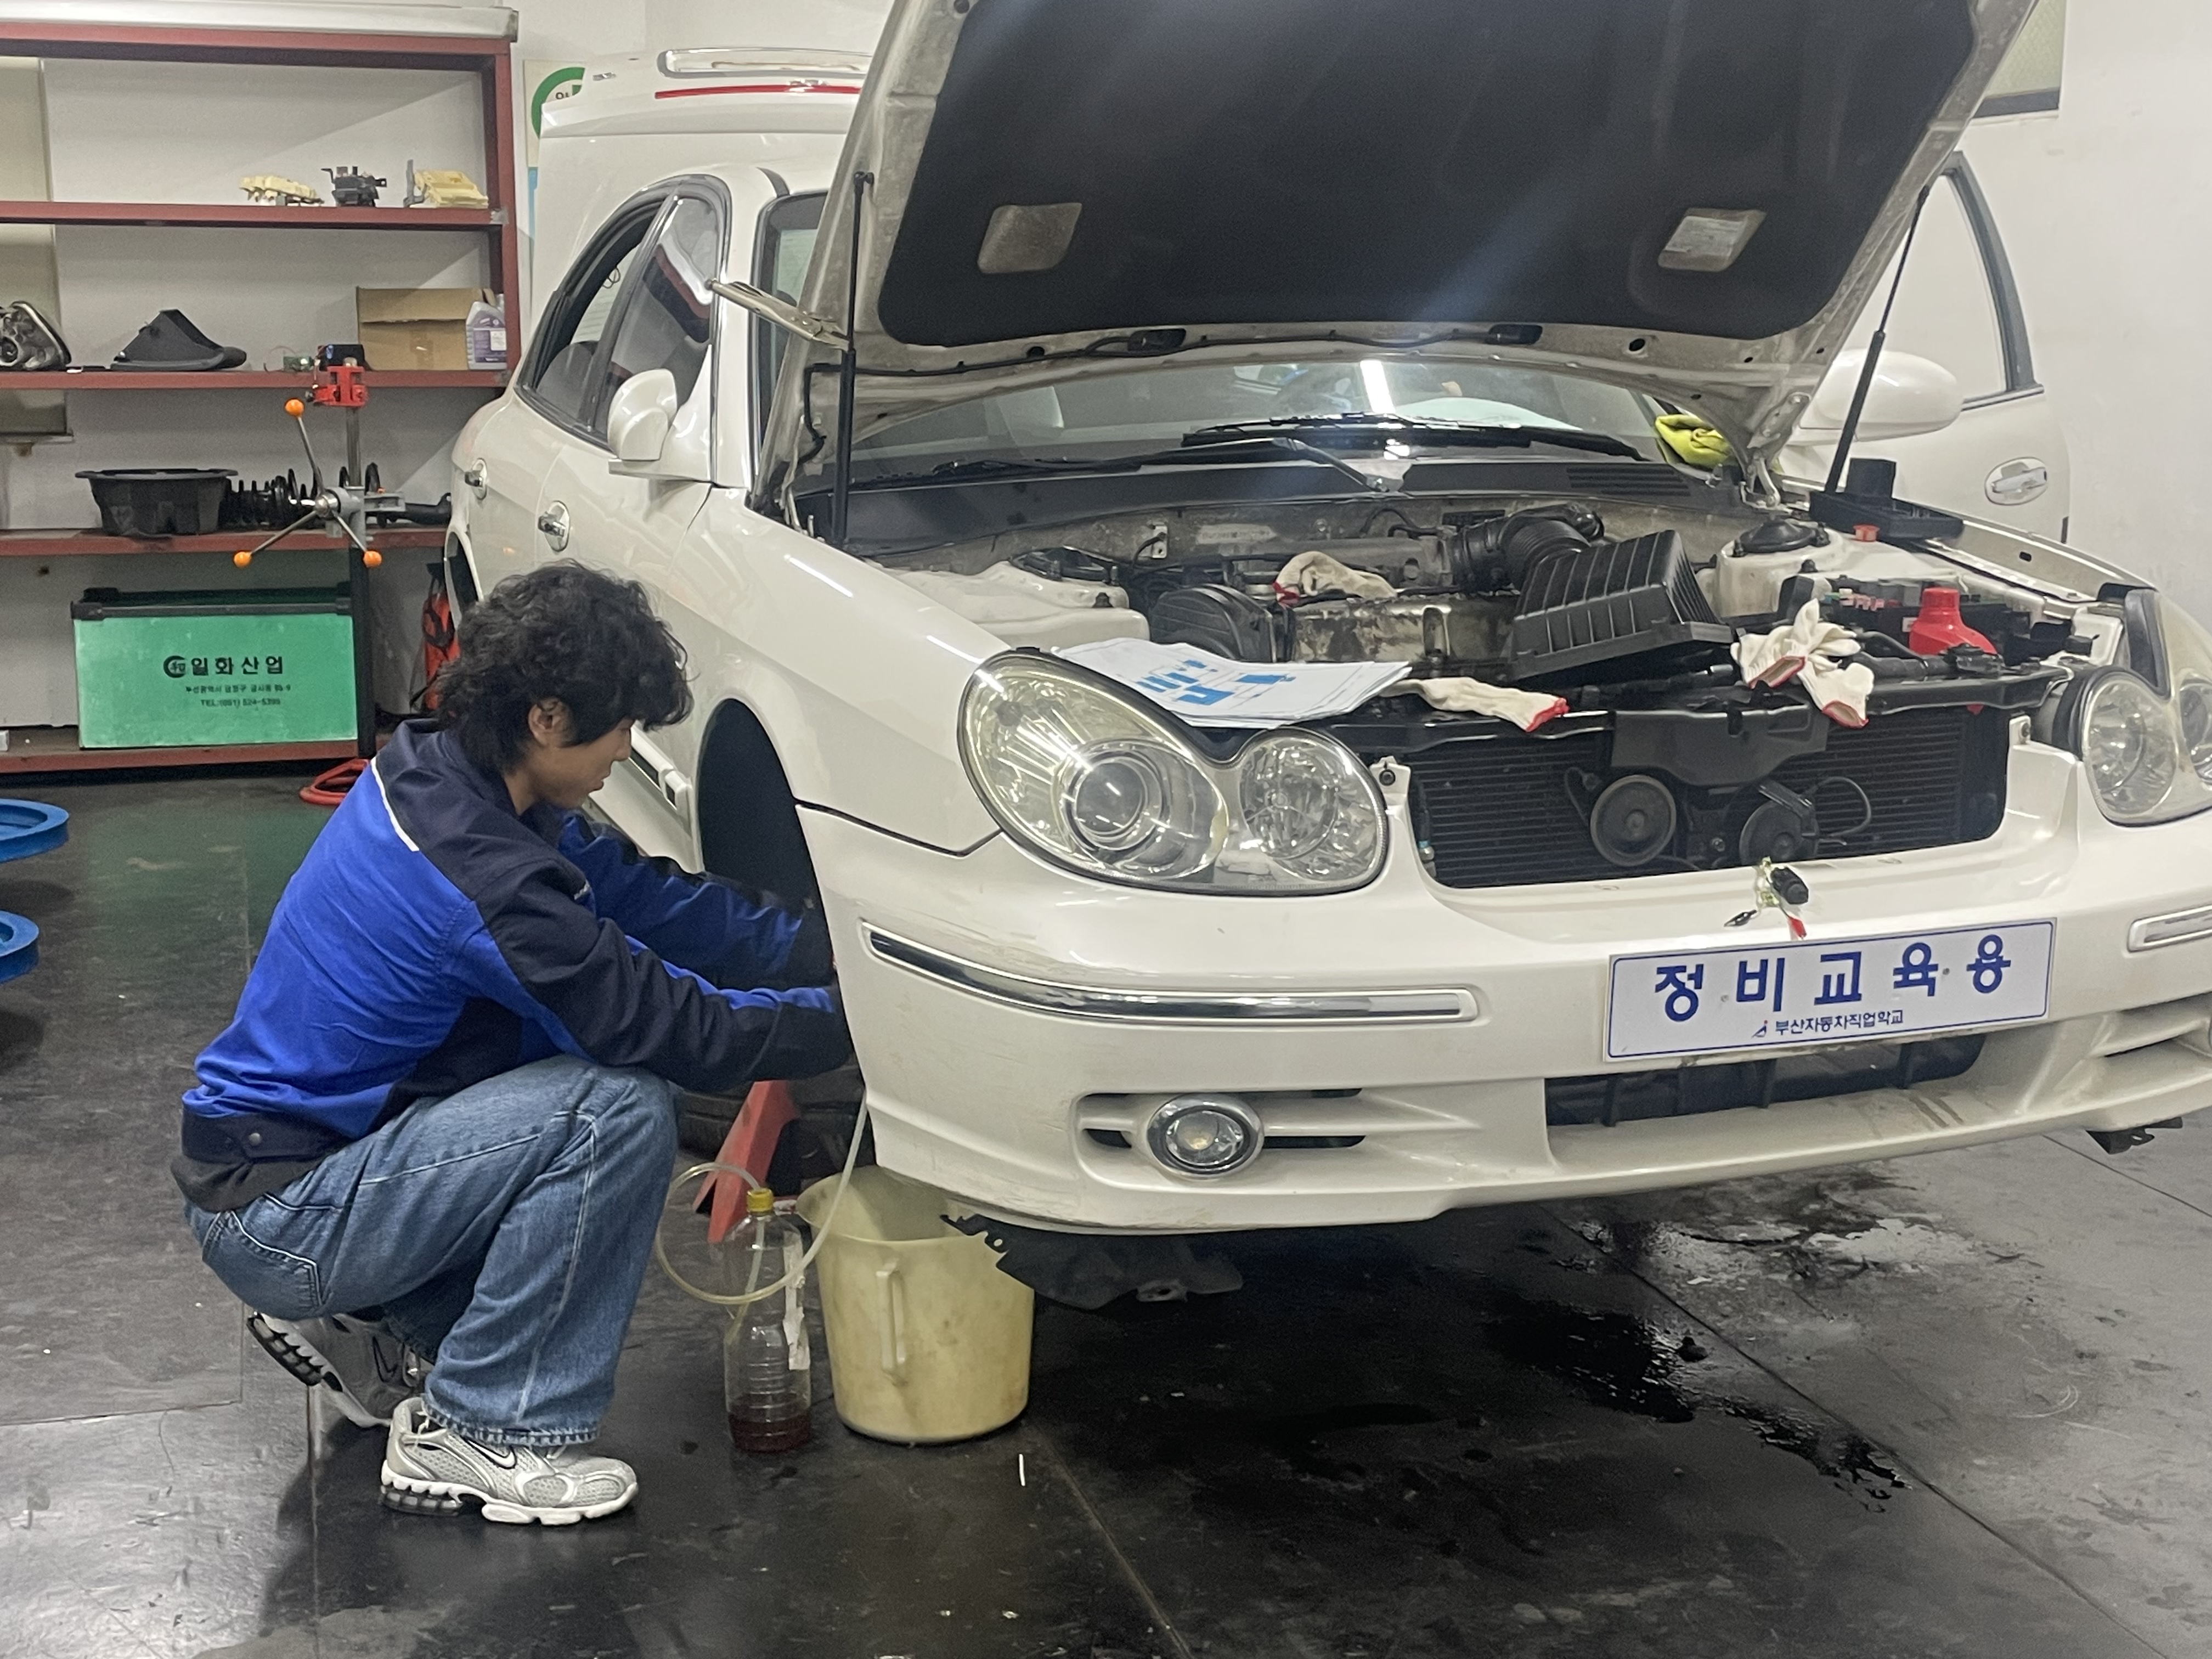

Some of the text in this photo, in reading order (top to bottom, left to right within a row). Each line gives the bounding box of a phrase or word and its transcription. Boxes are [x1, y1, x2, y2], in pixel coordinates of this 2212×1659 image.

[191, 656, 283, 676] 일화산업
[1655, 934, 2011, 1022] 정비교육용
[1775, 1009, 1903, 1035] 부산자동차직업학교
